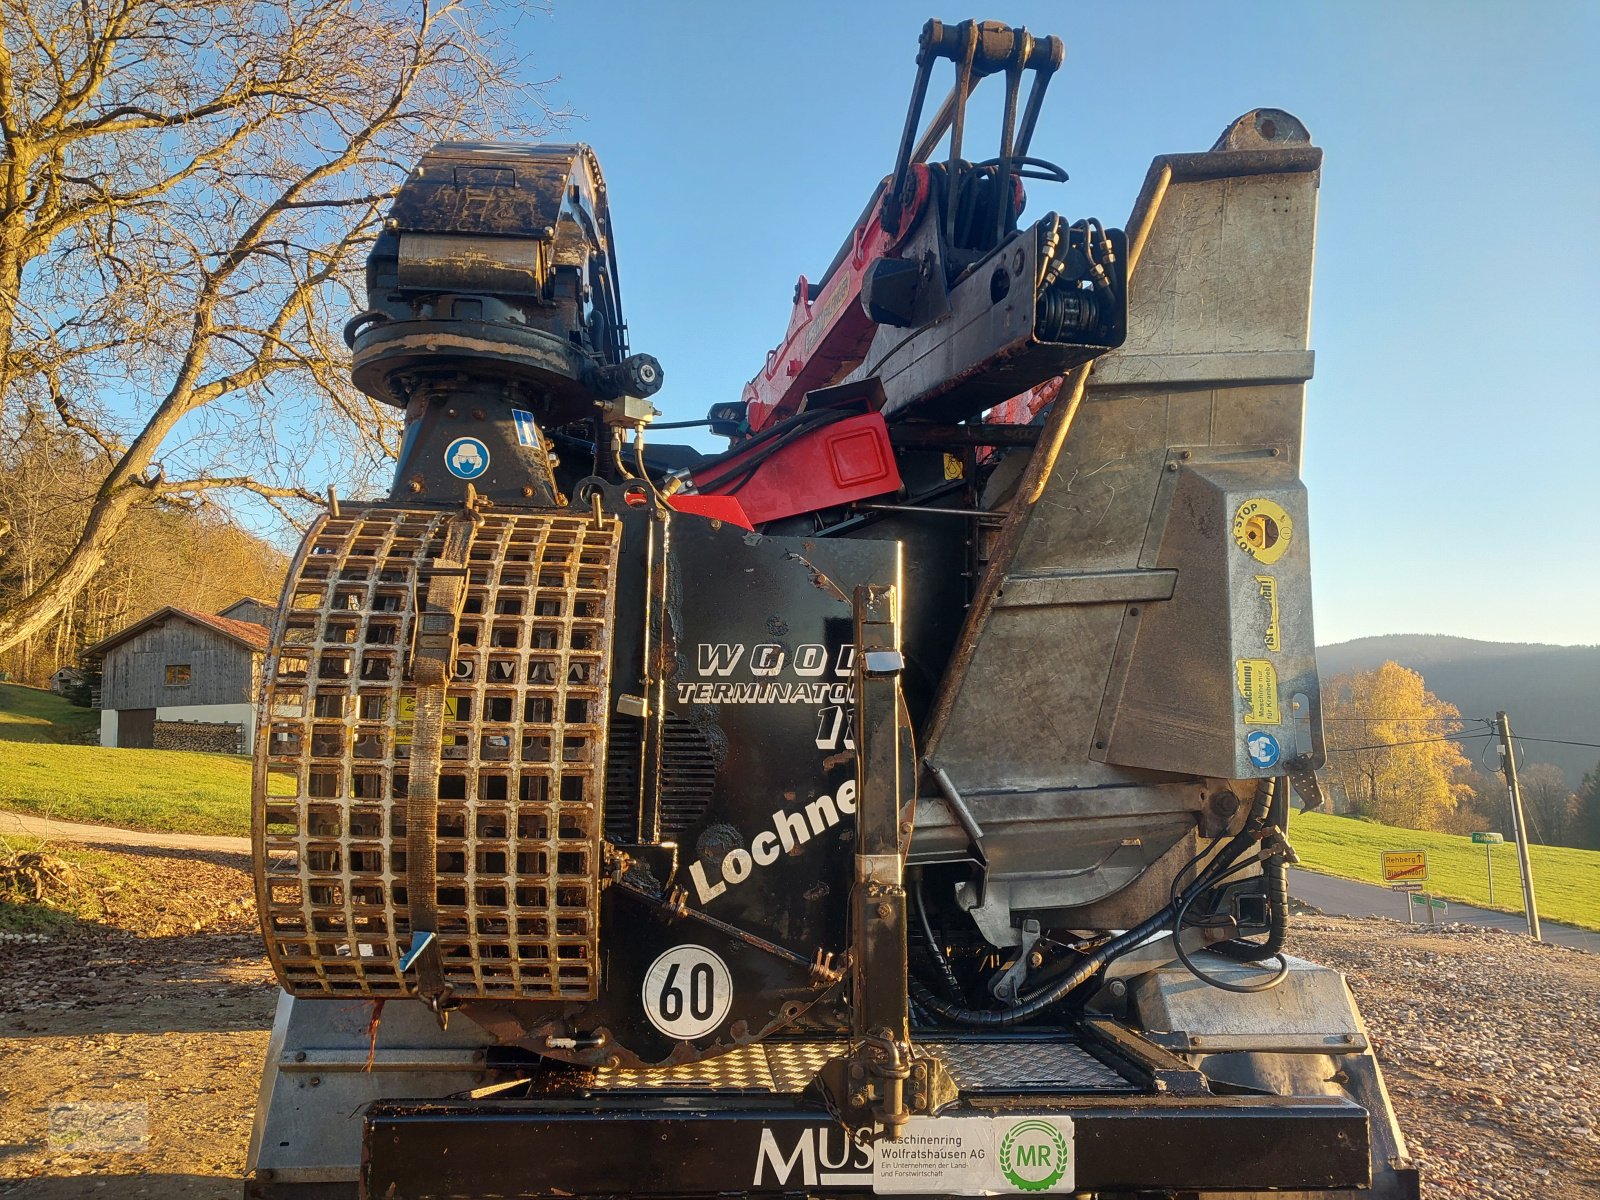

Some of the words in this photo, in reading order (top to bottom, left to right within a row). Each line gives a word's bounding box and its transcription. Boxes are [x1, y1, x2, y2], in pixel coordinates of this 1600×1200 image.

[677, 682, 855, 704] TERMINATO
[1257, 683, 1265, 718] Maschine
[688, 779, 856, 905] Lochne
[1386, 856, 1416, 865] Rehberg
[659, 962, 714, 1022] 60
[881, 1148, 967, 1159] Wolfratshausen
[969, 1149, 985, 1159] AG
[1016, 1145, 1052, 1167] MR
